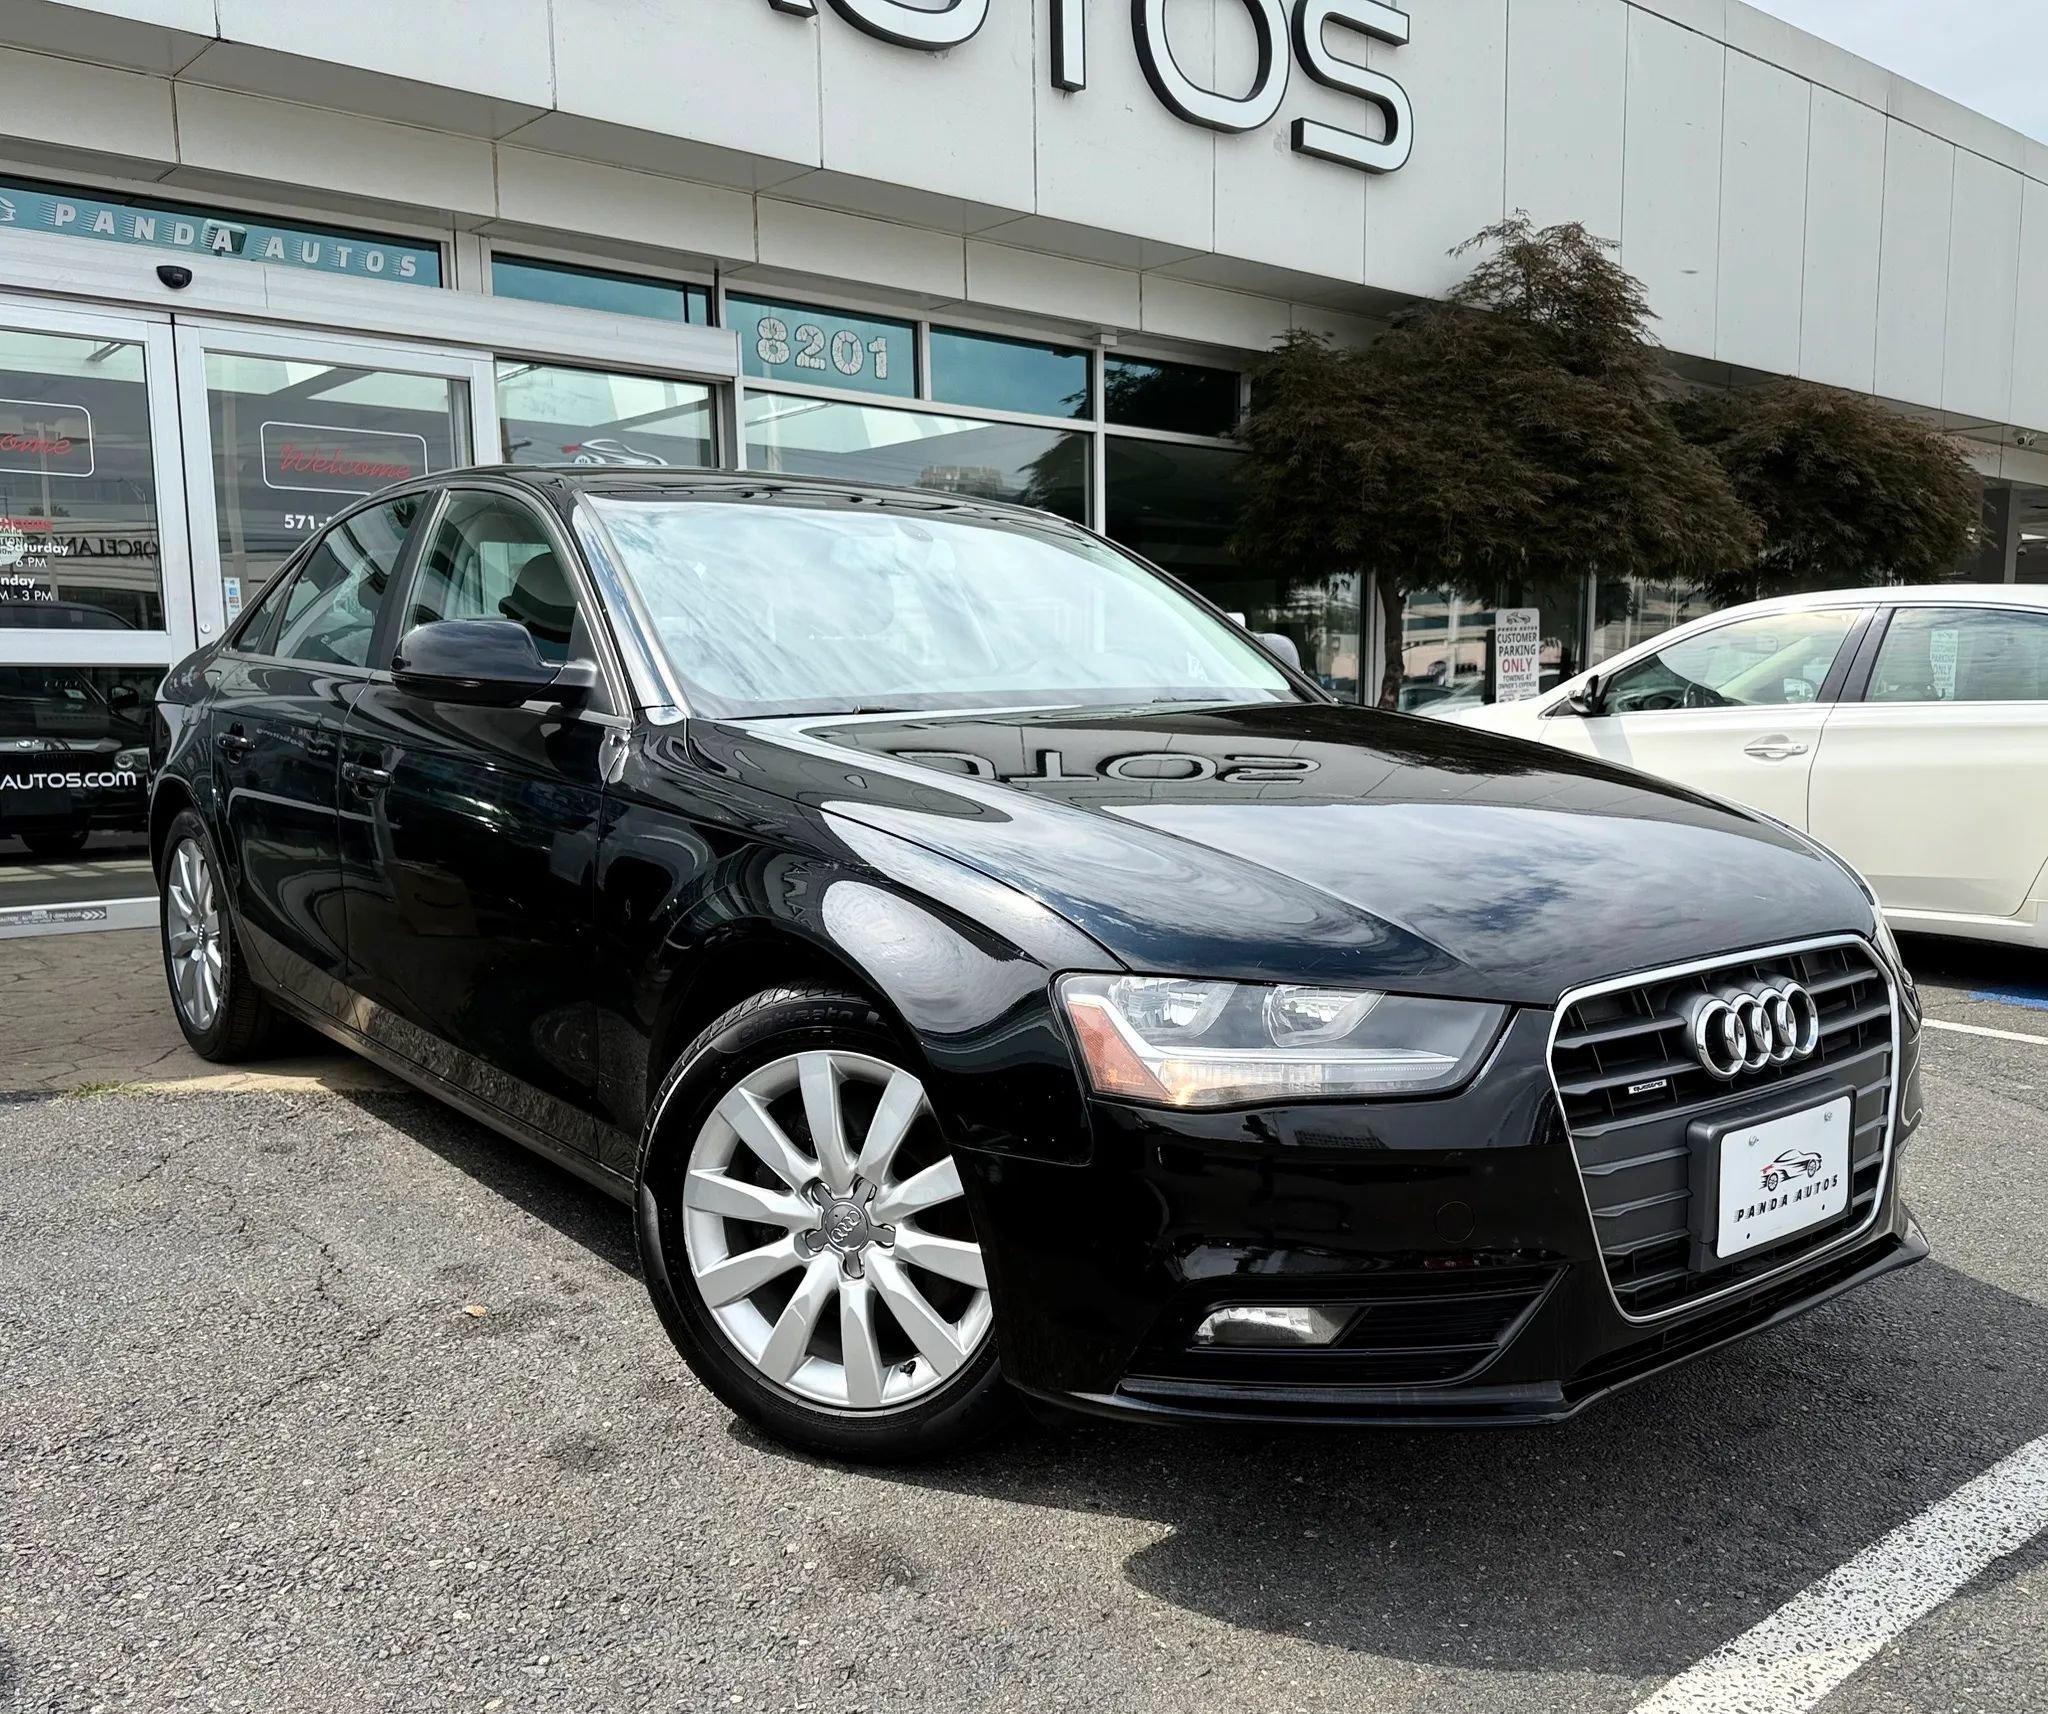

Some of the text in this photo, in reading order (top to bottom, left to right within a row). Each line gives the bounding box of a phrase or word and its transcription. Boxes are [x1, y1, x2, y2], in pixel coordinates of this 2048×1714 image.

[48, 202, 416, 278] PANDA AUTOS
[757, 316, 888, 379] 8201
[279, 441, 412, 479] Welcome
[7, 542, 68, 556] Saturday
[16, 556, 47, 568] 6 PM
[22, 590, 30, 601] 3
[34, 590, 53, 601] PM
[1497, 633, 1537, 644] CUSTOMER
[1499, 644, 1536, 656] PARKING
[1502, 658, 1532, 673] ONLY
[1735, 1174, 1838, 1223] PANDA AUTOS
